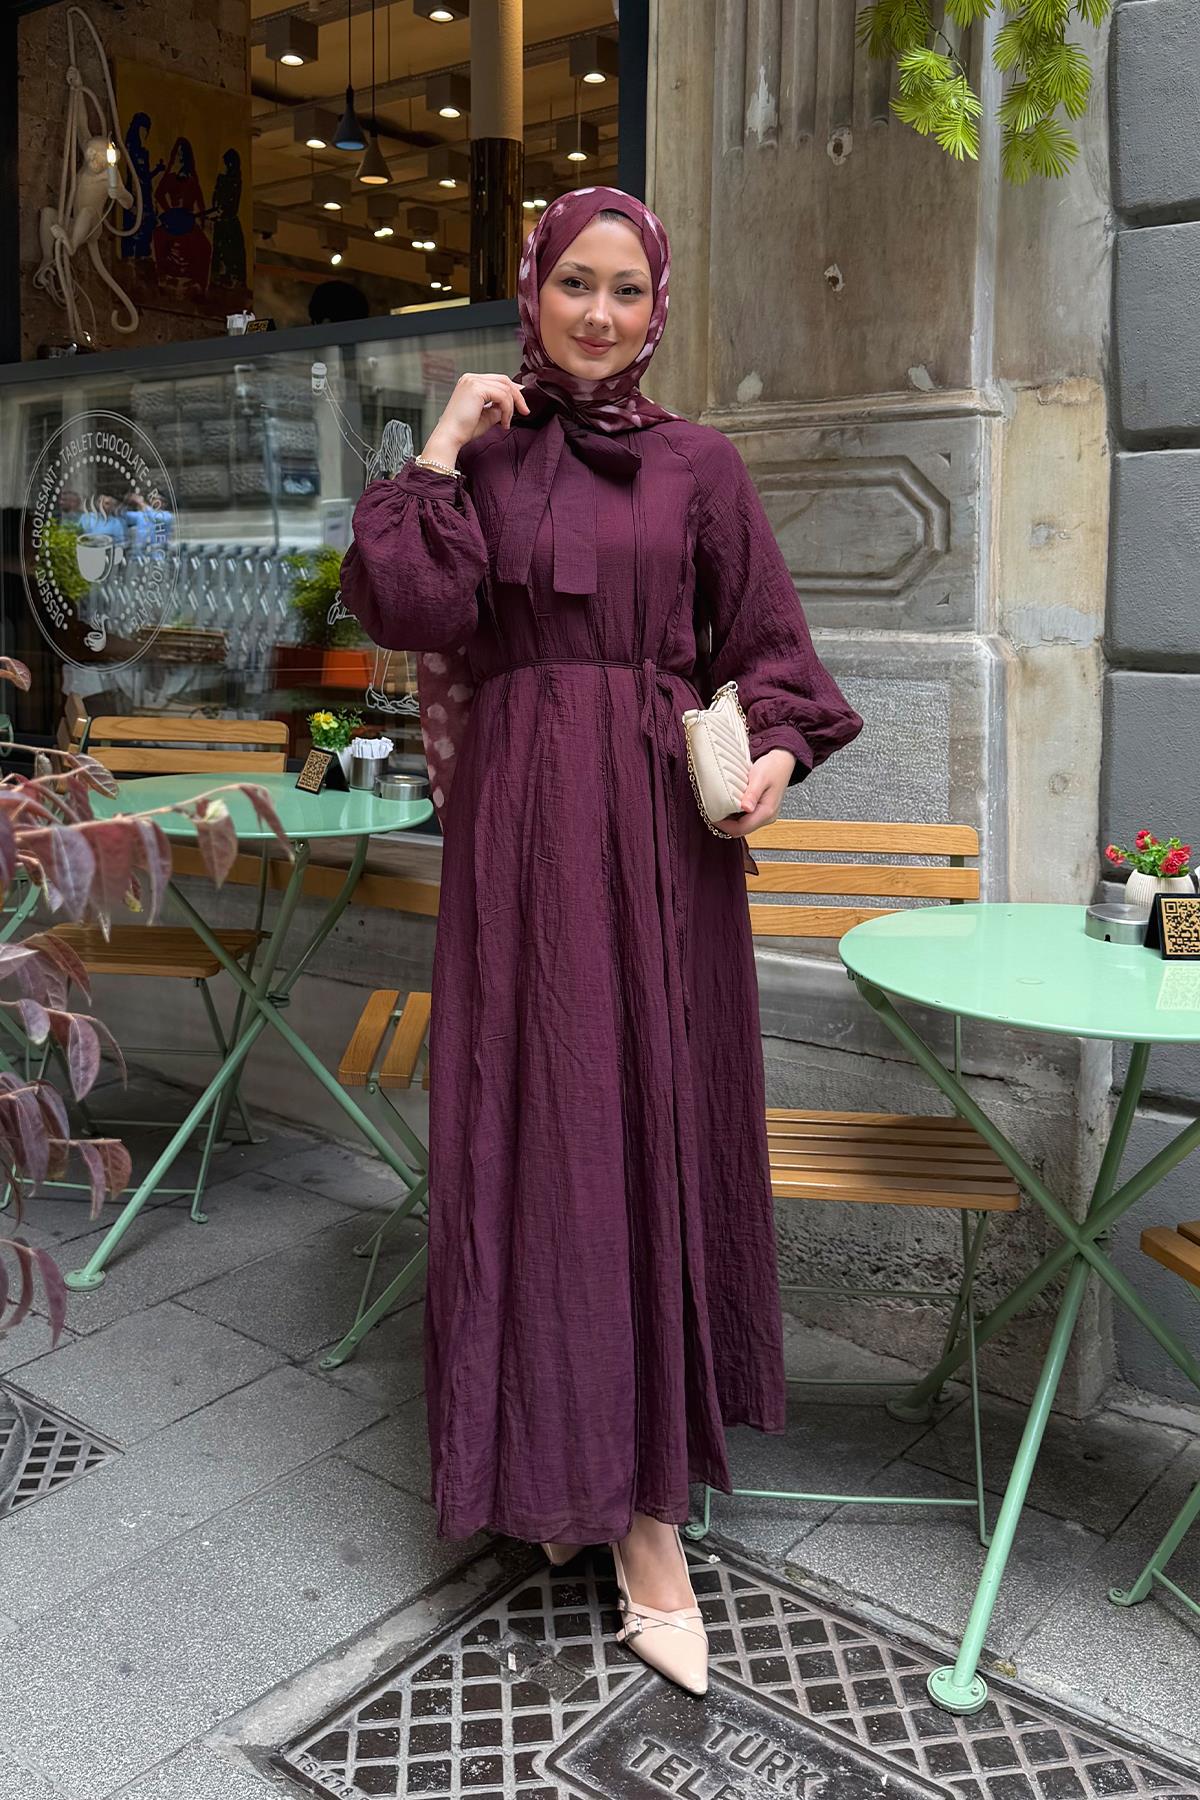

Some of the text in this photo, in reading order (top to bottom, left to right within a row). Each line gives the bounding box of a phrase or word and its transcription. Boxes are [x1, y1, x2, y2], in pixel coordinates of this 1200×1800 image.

[59, 432, 150, 482] TABLET CHOCOLATE
[32, 465, 58, 549] CROISSANT
[35, 568, 65, 628] DESSERT
[706, 1720, 824, 1800] TÜRK
